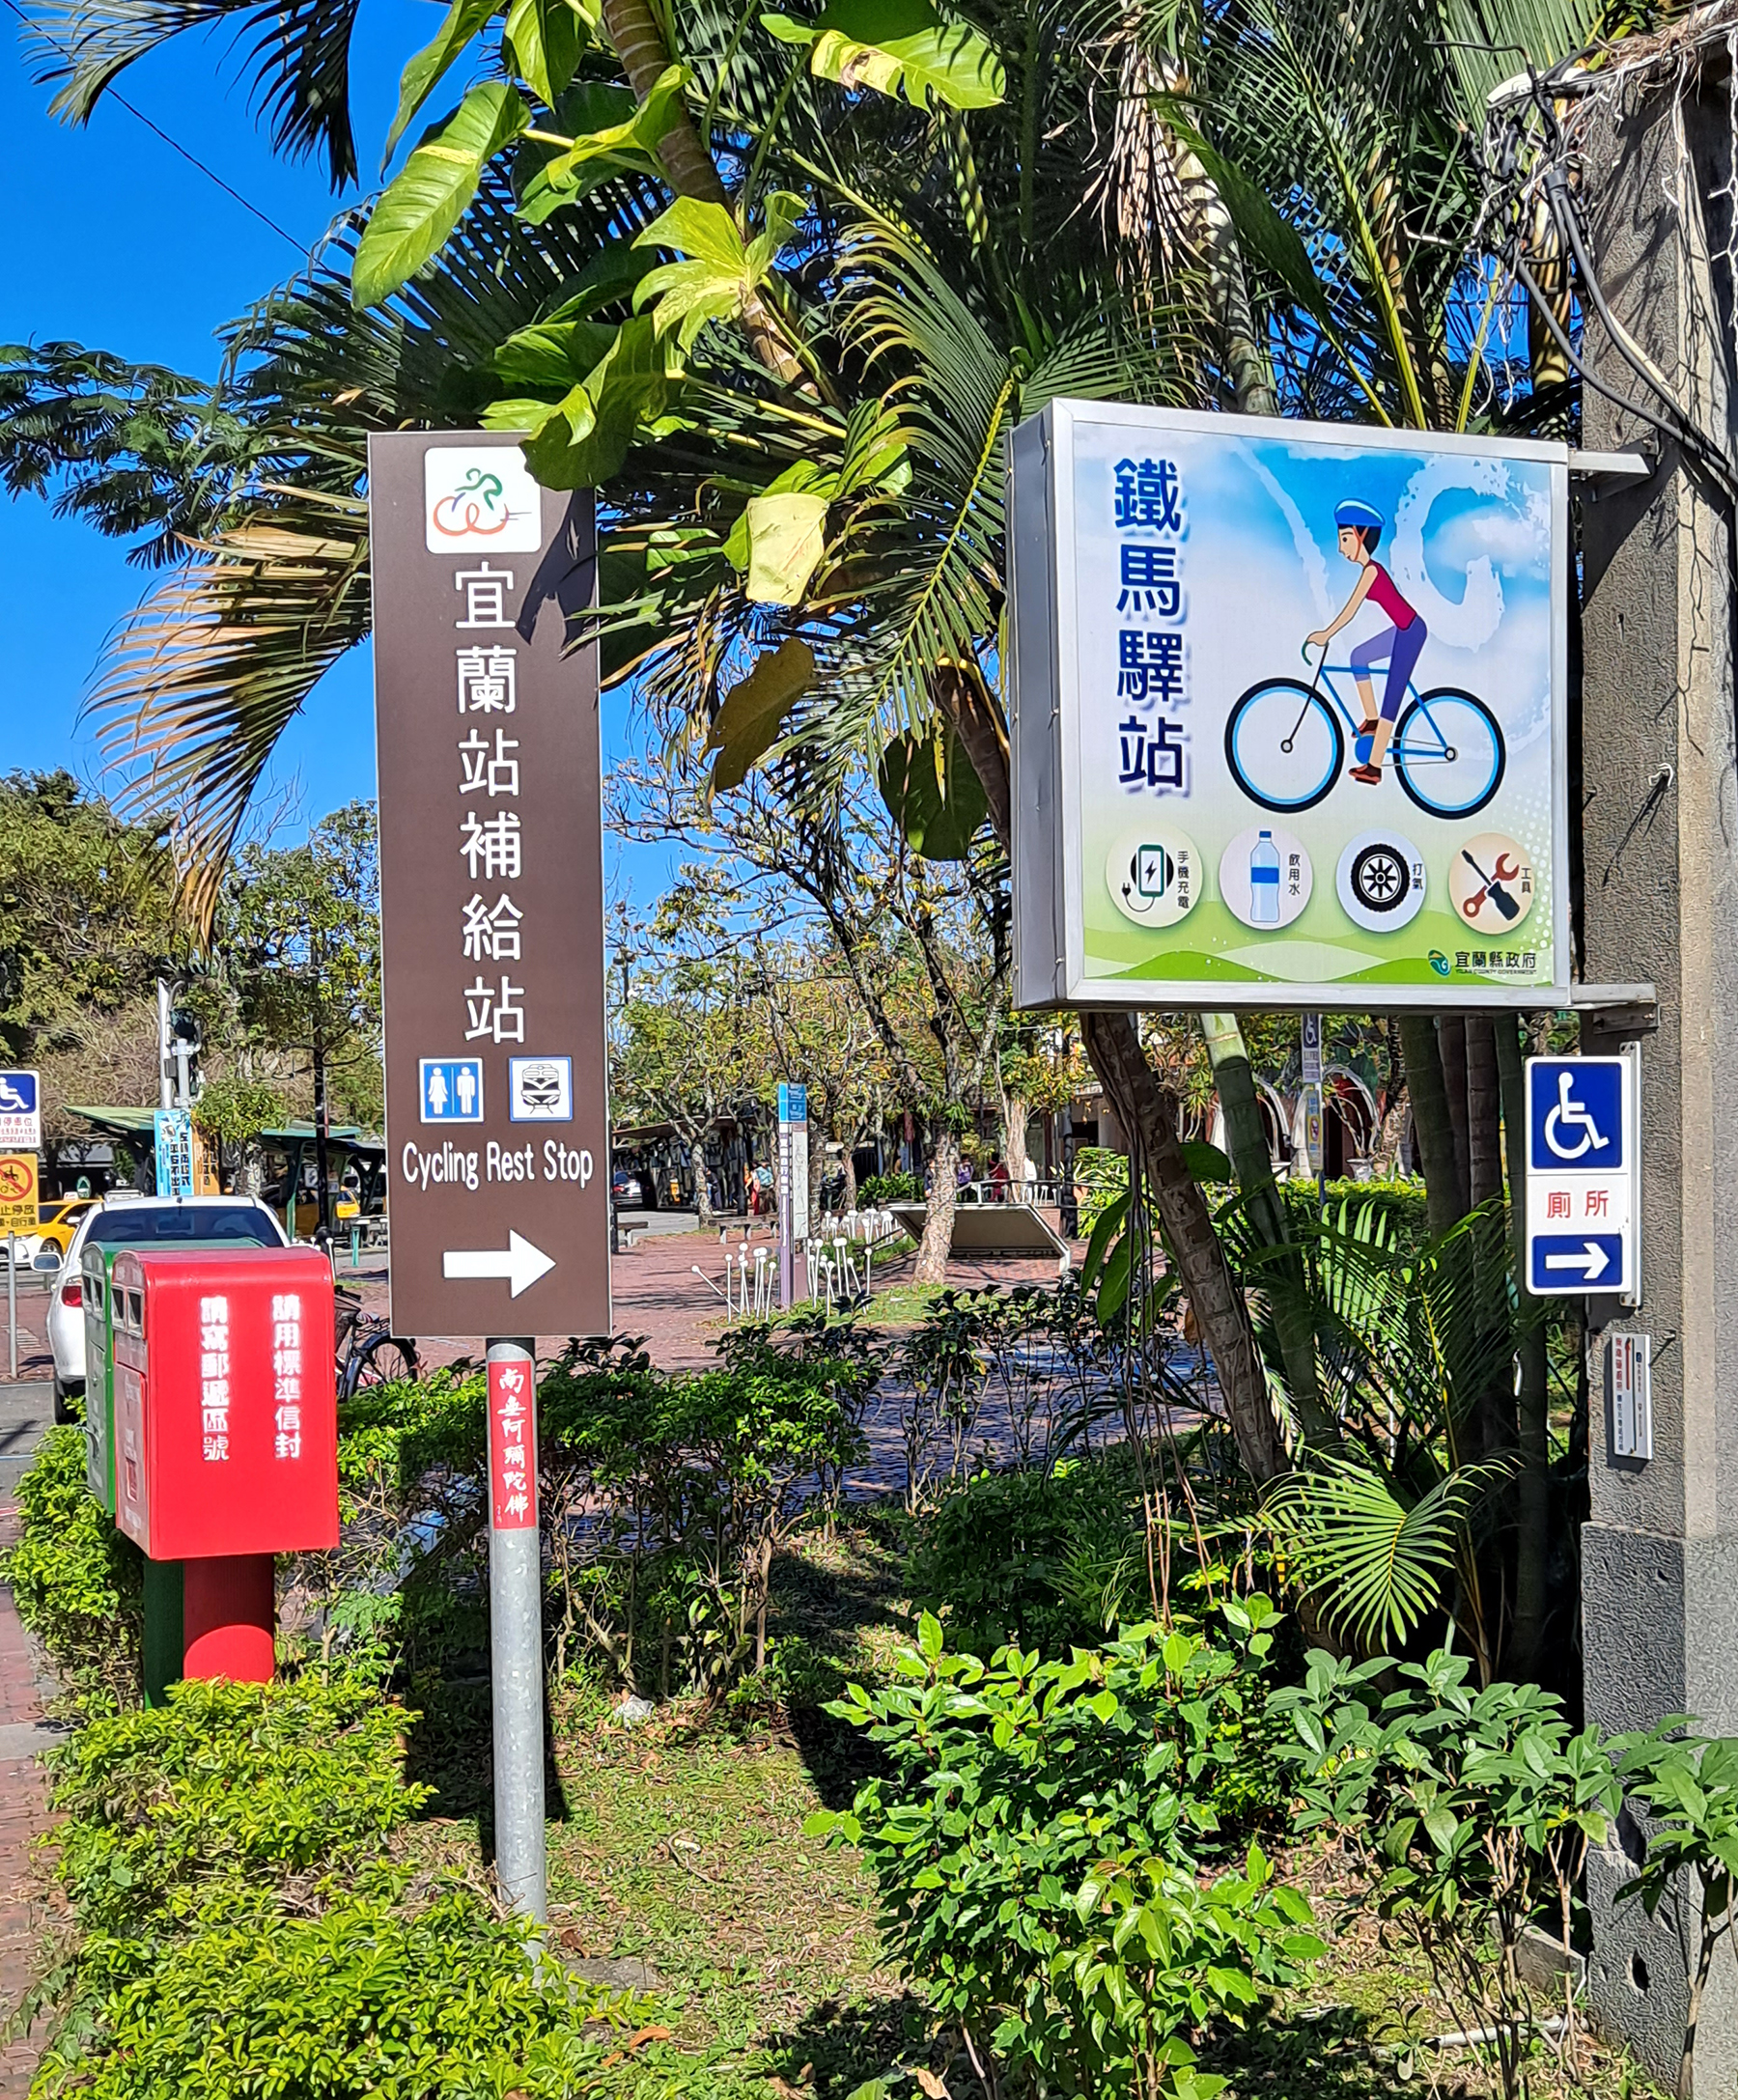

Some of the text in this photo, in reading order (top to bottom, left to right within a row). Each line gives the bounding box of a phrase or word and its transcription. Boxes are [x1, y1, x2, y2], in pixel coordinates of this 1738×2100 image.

[1113, 458, 1184, 788] 鐵馬驛站
[455, 561, 524, 1044] 宜蘭站補給站
[1177, 851, 1190, 910] 手機充電
[1288, 853, 1301, 896] 飲用水
[1413, 863, 1423, 890] 打氣
[1521, 867, 1532, 894] 工具
[1454, 951, 1536, 969] 宜蘭縣政府
[403, 1139, 594, 1191] Cycling Rest Stop
[1546, 1190, 1610, 1218] 廁所
[200, 1295, 230, 1461] 請寫郵遞區號
[271, 1294, 301, 1459] 請用標準信封
[497, 1368, 529, 1523] 南無阿彌陀佛
